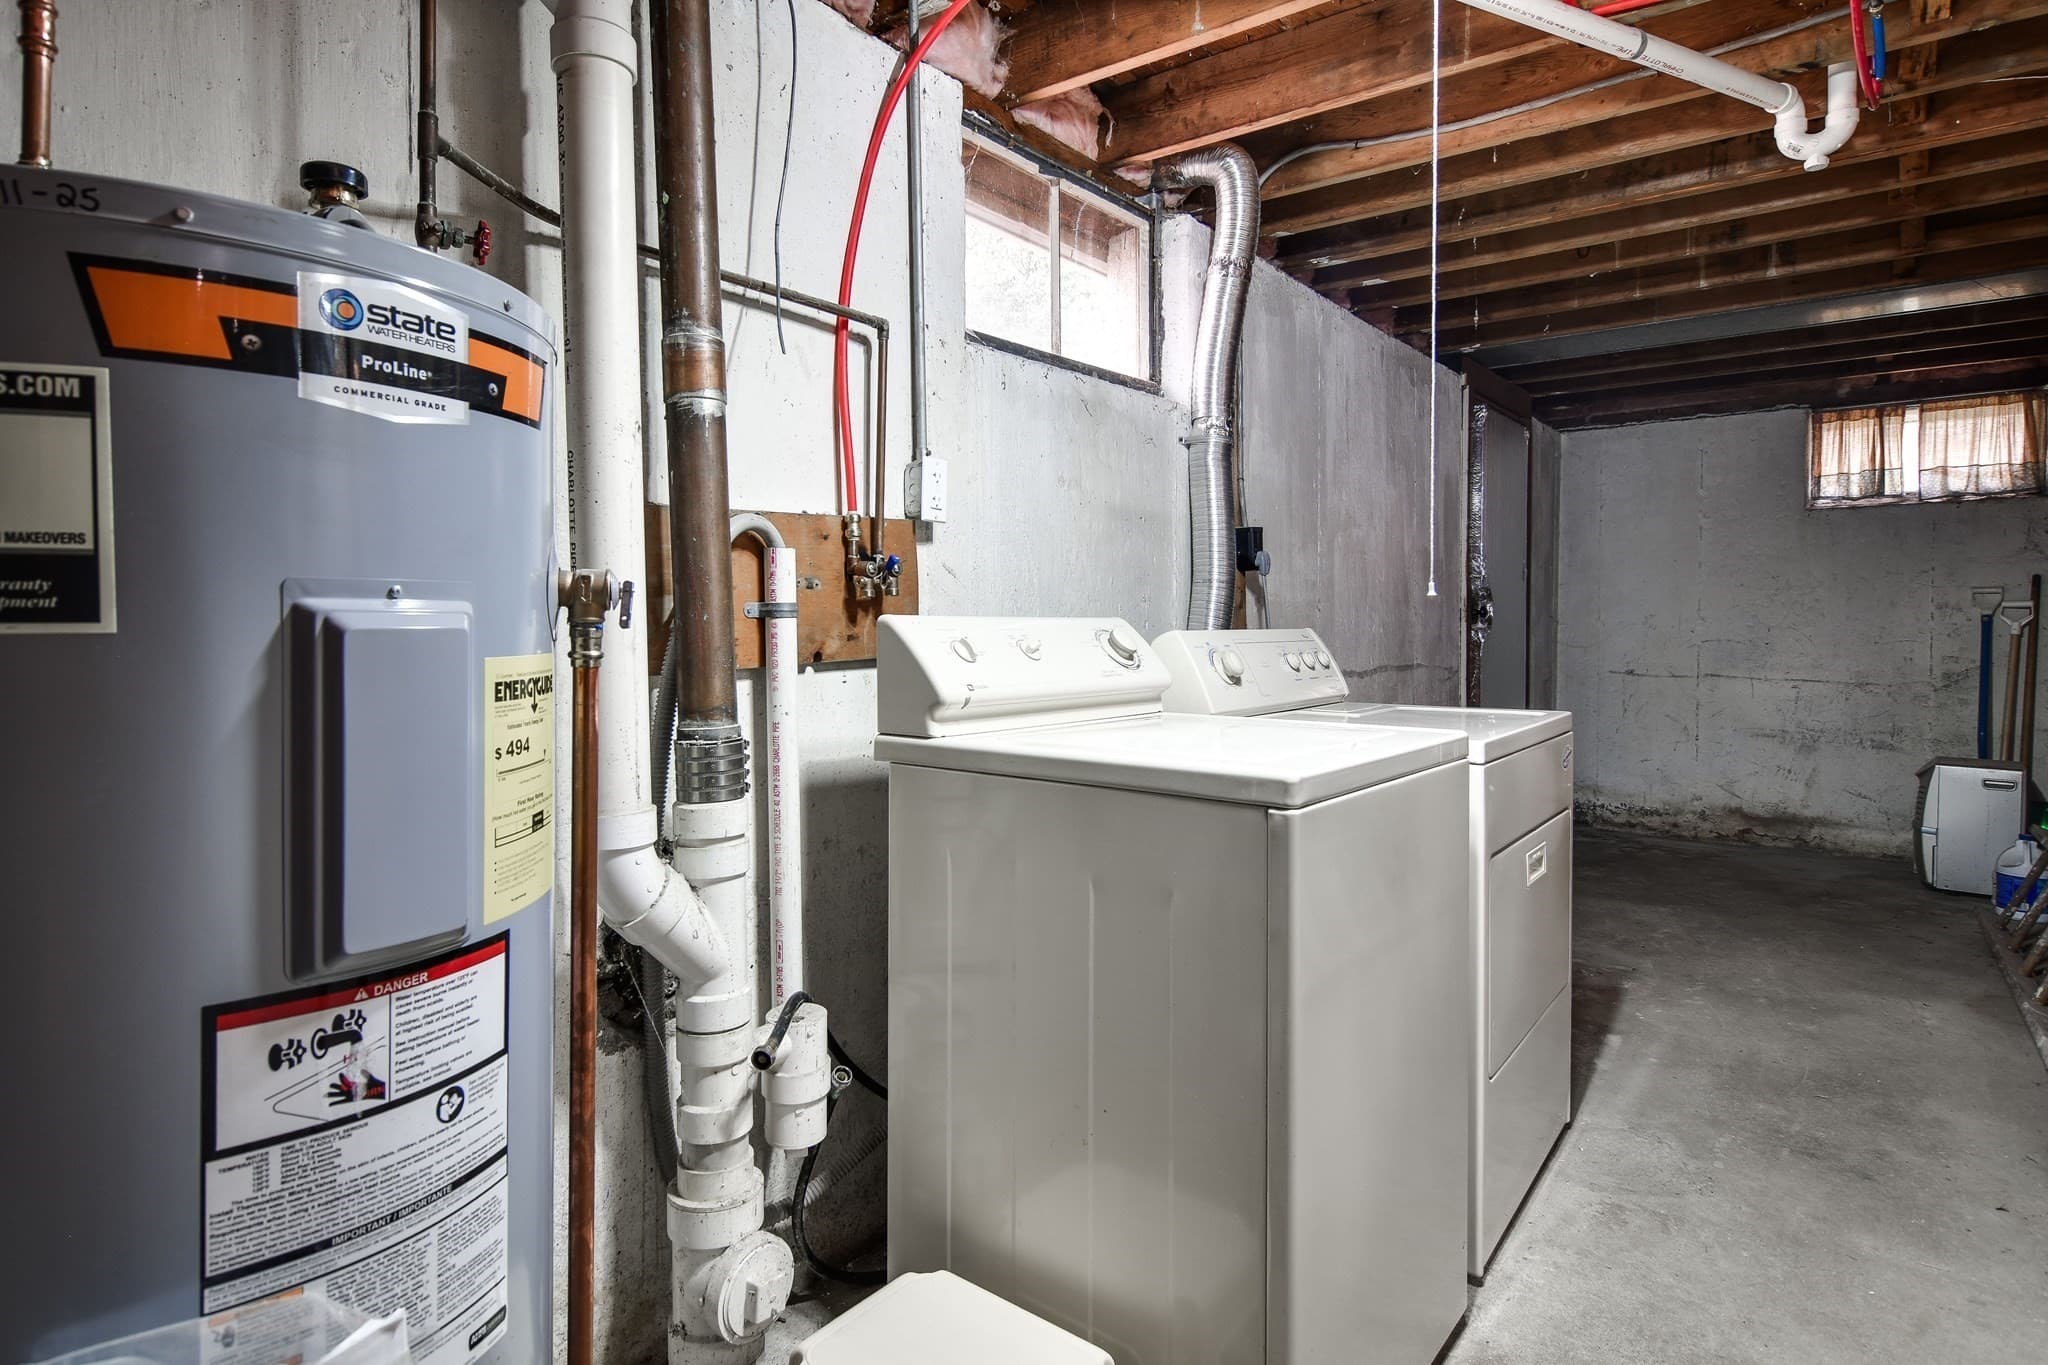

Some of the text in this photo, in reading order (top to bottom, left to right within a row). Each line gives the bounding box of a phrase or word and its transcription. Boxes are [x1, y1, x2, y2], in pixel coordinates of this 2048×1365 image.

[367, 304, 456, 343] state
[368, 325, 456, 353] WATER HEATERS
[334, 386, 446, 412] COMMERCIAL GRADE
[567, 450, 576, 534] CHARLOTTE
[4, 531, 86, 545] MAKEOVERS
[772, 721, 780, 733] PIPE
[506, 736, 530, 757] 494
[772, 735, 780, 763] CHARLOTTE
[773, 784, 781, 798] ASTM
[374, 971, 428, 996] DANGER
[776, 984, 784, 998] ASTM
[332, 1215, 391, 1246] IMPORTANT
[400, 1184, 452, 1216] IMPORTANTE
